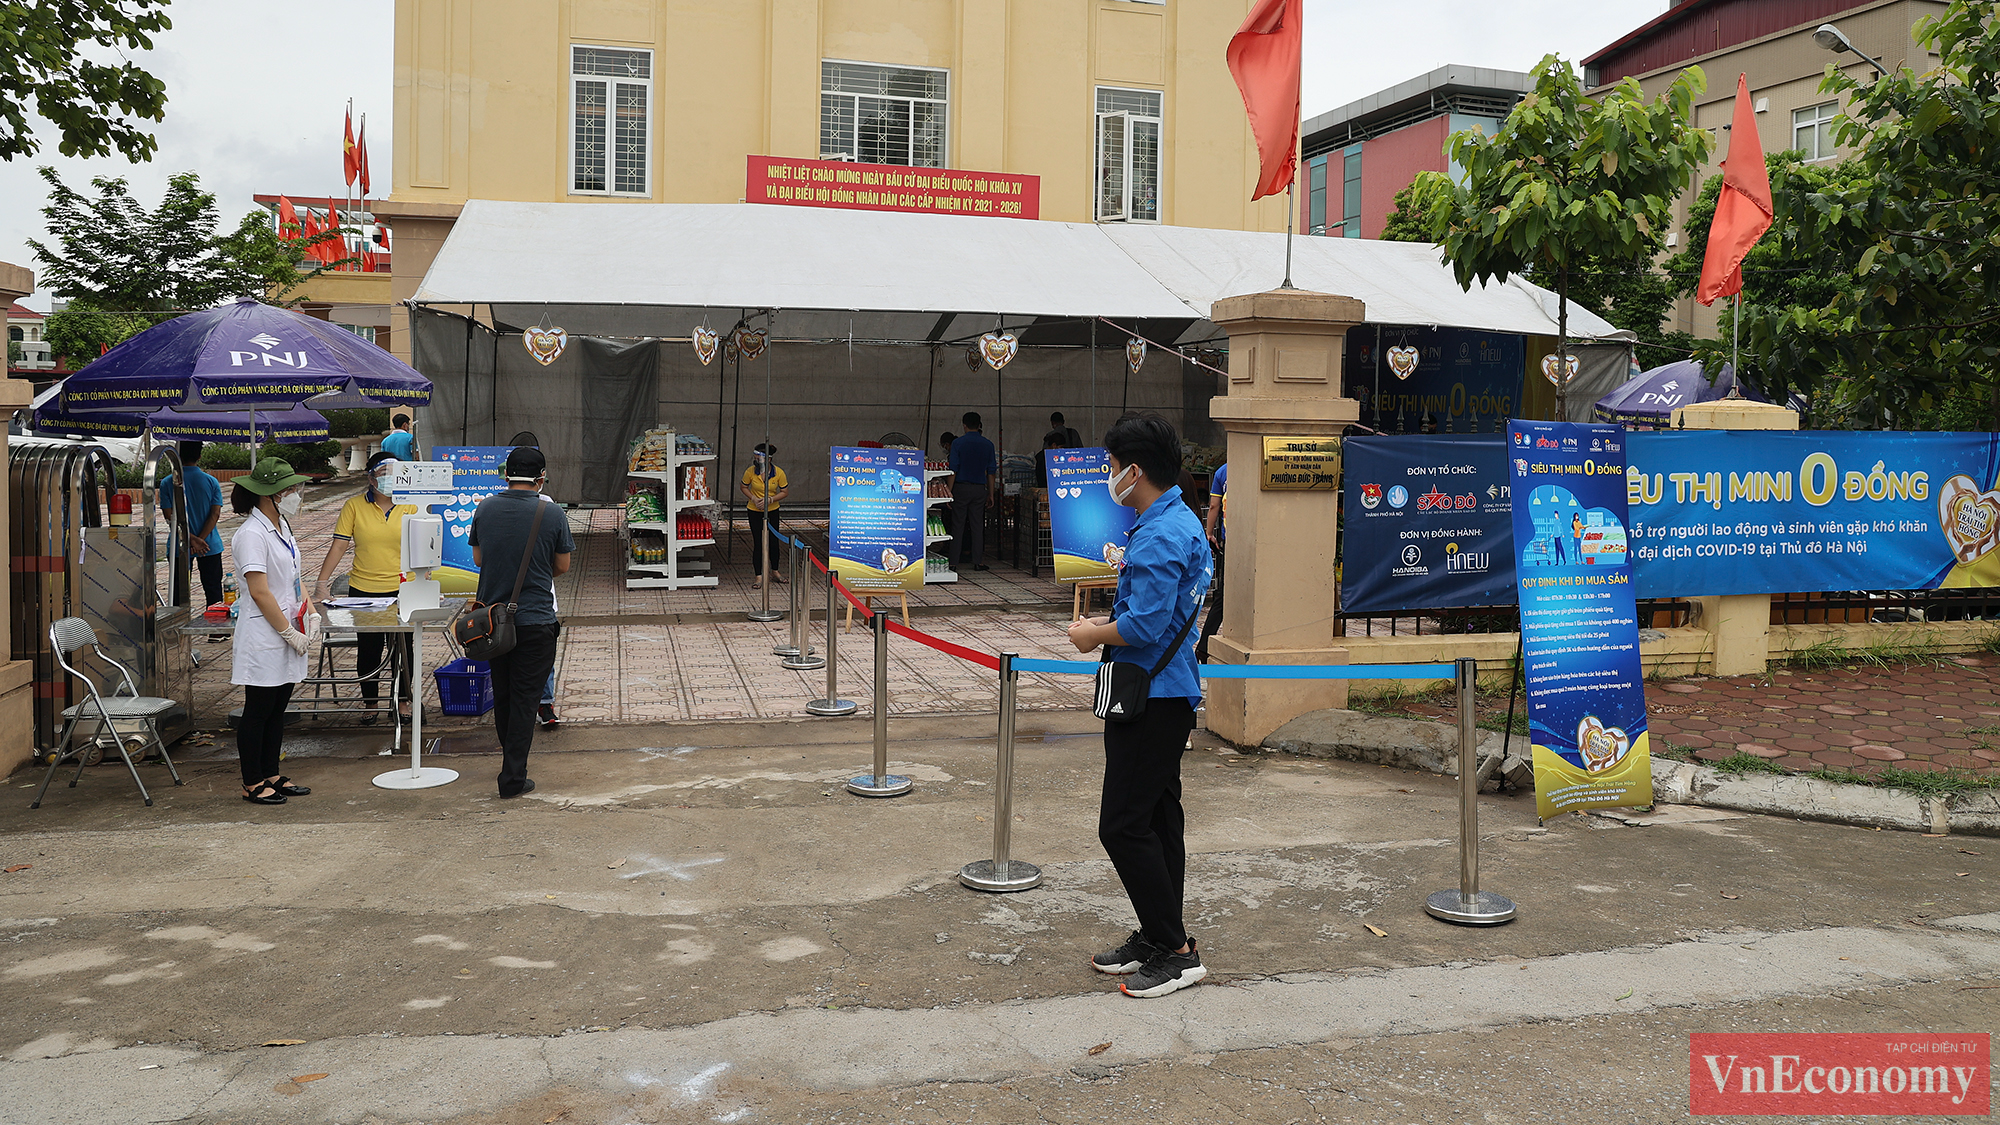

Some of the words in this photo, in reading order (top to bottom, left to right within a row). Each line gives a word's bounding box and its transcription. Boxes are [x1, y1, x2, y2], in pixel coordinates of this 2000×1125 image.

[767, 163, 792, 182] NHIỆT
[793, 165, 811, 183] LIỆT
[812, 167, 834, 182] CHÀO
[836, 168, 860, 184] MỪNG
[862, 170, 884, 186] NGÀY
[886, 170, 902, 186] BẦU
[904, 171, 916, 188] CỬ
[917, 176, 930, 191] ĐẠI
[932, 172, 950, 190] BIỂU
[952, 175, 973, 192] QUỐC
[975, 178, 987, 195] HỘI
[990, 179, 1010, 194] KHÓA
[1012, 182, 1022, 194] XV
[766, 183, 777, 198] VÀ
[779, 186, 793, 202] ĐẠI
[795, 183, 814, 200] BIỂU
[816, 186, 830, 204] HỘI
[832, 186, 854, 203] ĐỒNG
[856, 189, 879, 204] NHÂN
[881, 191, 897, 206] DÂN
[900, 192, 915, 207] CÁC
[917, 192, 933, 208] CẤP
[935, 195, 960, 212] NHIỆM
[963, 196, 973, 211] KỲ
[974, 199, 992, 212] 2021
[1000, 200, 1021, 214] 2026!
[228, 351, 309, 368] PNJ
[1429, 346, 1441, 360] PNJ
[201, 386, 219, 396] CÔNG
[220, 387, 226, 395] TY
[228, 382, 237, 395] CỔ
[254, 384, 269, 394] VÀNG
[270, 385, 282, 396] BẠC
[283, 383, 291, 393] ĐÁ
[292, 383, 303, 394] QUÝ
[304, 383, 315, 393] PHÚ
[1371, 390, 1396, 411] SIÊU
[1398, 395, 1418, 416] THỊ
[1420, 395, 1446, 412] MINI
[1450, 382, 1466, 416] 0
[1468, 388, 1511, 415] ĐỒNG
[1638, 392, 1683, 407] PNJ
[1287, 443, 1302, 452] TRỤ
[1306, 441, 1317, 451] SỞ
[1101, 464, 1109, 473] 0
[1407, 466, 1426, 476] ĐƠN
[1427, 467, 1437, 476] VỊ
[1438, 464, 1450, 474] TỔ
[1451, 464, 1477, 474] CHỨC:
[1531, 462, 1548, 474] SIÊU
[1550, 464, 1564, 476] THỊ
[1565, 465, 1582, 474] MINI
[1584, 459, 1595, 476] 0
[1597, 462, 1622, 475] ĐỒNG
[396, 476, 411, 485] PNJ
[847, 476, 855, 486] 0
[856, 478, 876, 486] ĐỒNG
[1298, 472, 1311, 483] ĐỨC
[1669, 472, 1721, 510] THỊ
[1729, 471, 1792, 502] MINI
[1800, 452, 1837, 506] 0
[1842, 460, 1928, 501] ĐỒNG
[1454, 492, 1477, 509] ĐỎ
[1963, 504, 1972, 514] HÀ
[1974, 508, 1987, 520] NỘI
[1647, 526, 1666, 540] trợ
[1670, 524, 1708, 539] người
[1712, 524, 1730, 535] lao
[1734, 522, 1768, 538] động
[1772, 522, 1785, 534] và
[1789, 522, 1814, 533] sinh
[1819, 521, 1844, 533] viên
[1847, 522, 1869, 535] gặp
[1873, 520, 1895, 532] khó
[1899, 520, 1927, 532] khăn
[1958, 513, 1973, 524] TRÁI
[1974, 519, 1985, 531] TIM
[1400, 531, 1419, 539] ĐƠN
[1421, 531, 1430, 540] VỊ
[1431, 528, 1454, 538] ĐỒNG
[1457, 527, 1482, 537] HÀNH:
[1959, 524, 1979, 538] HỒNG
[1638, 546, 1658, 561] đại
[1662, 544, 1692, 561] dịch
[1696, 543, 1755, 556] COVID-19
[1760, 542, 1776, 557] tại
[1780, 541, 1801, 553] Thủ
[1805, 541, 1822, 553] đô
[1827, 541, 1843, 553] Hà
[1847, 540, 1867, 555] Nội
[1522, 578, 1537, 589] QUY
[1538, 577, 1557, 589] ĐỊNH
[1559, 576, 1573, 586] KHI
[1575, 576, 1584, 585] ĐI
[1586, 575, 1606, 585] MUA
[1608, 572, 1628, 584] SẮM
